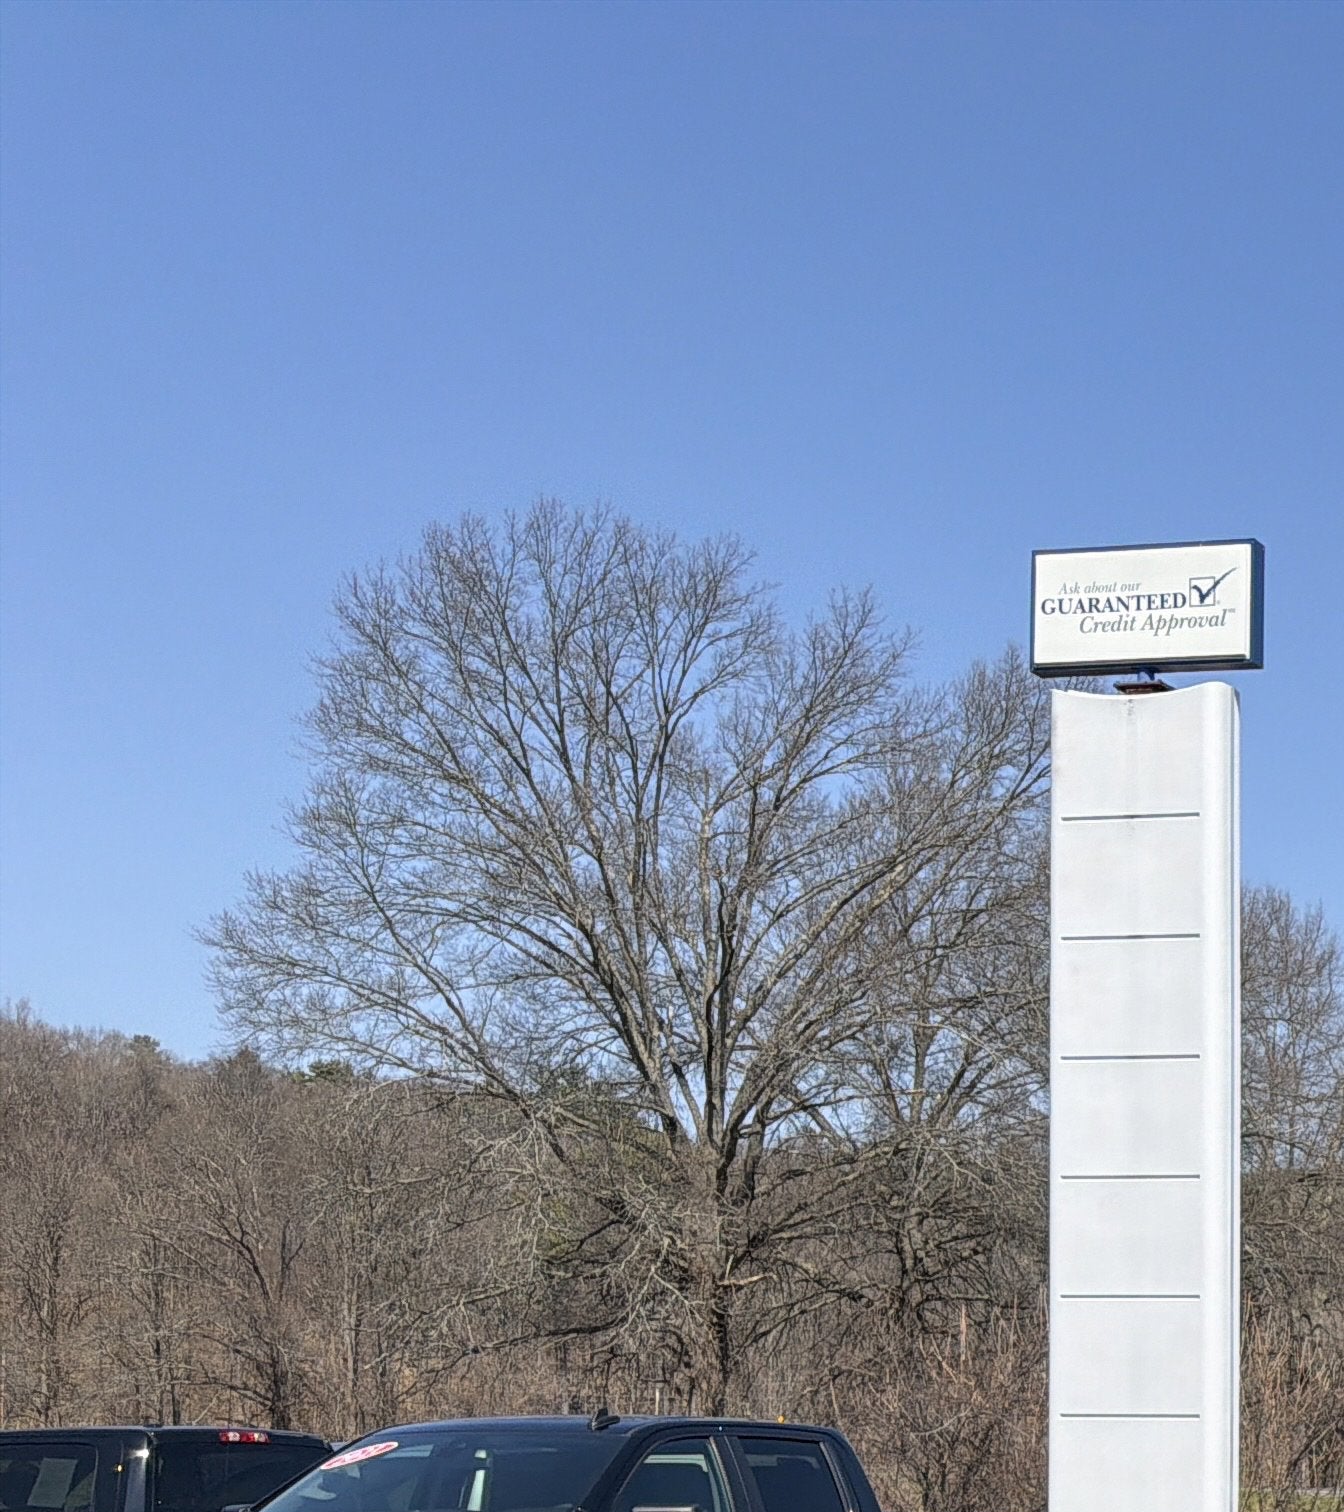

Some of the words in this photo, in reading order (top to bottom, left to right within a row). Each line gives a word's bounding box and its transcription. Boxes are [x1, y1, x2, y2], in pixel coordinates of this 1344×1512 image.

[1059, 582, 1080, 595] Ask
[1084, 581, 1117, 594] about
[1120, 582, 1141, 592] our
[1041, 592, 1187, 615] GUARANTEED
[1080, 614, 1136, 633] Credit
[1141, 608, 1227, 636] Approval
